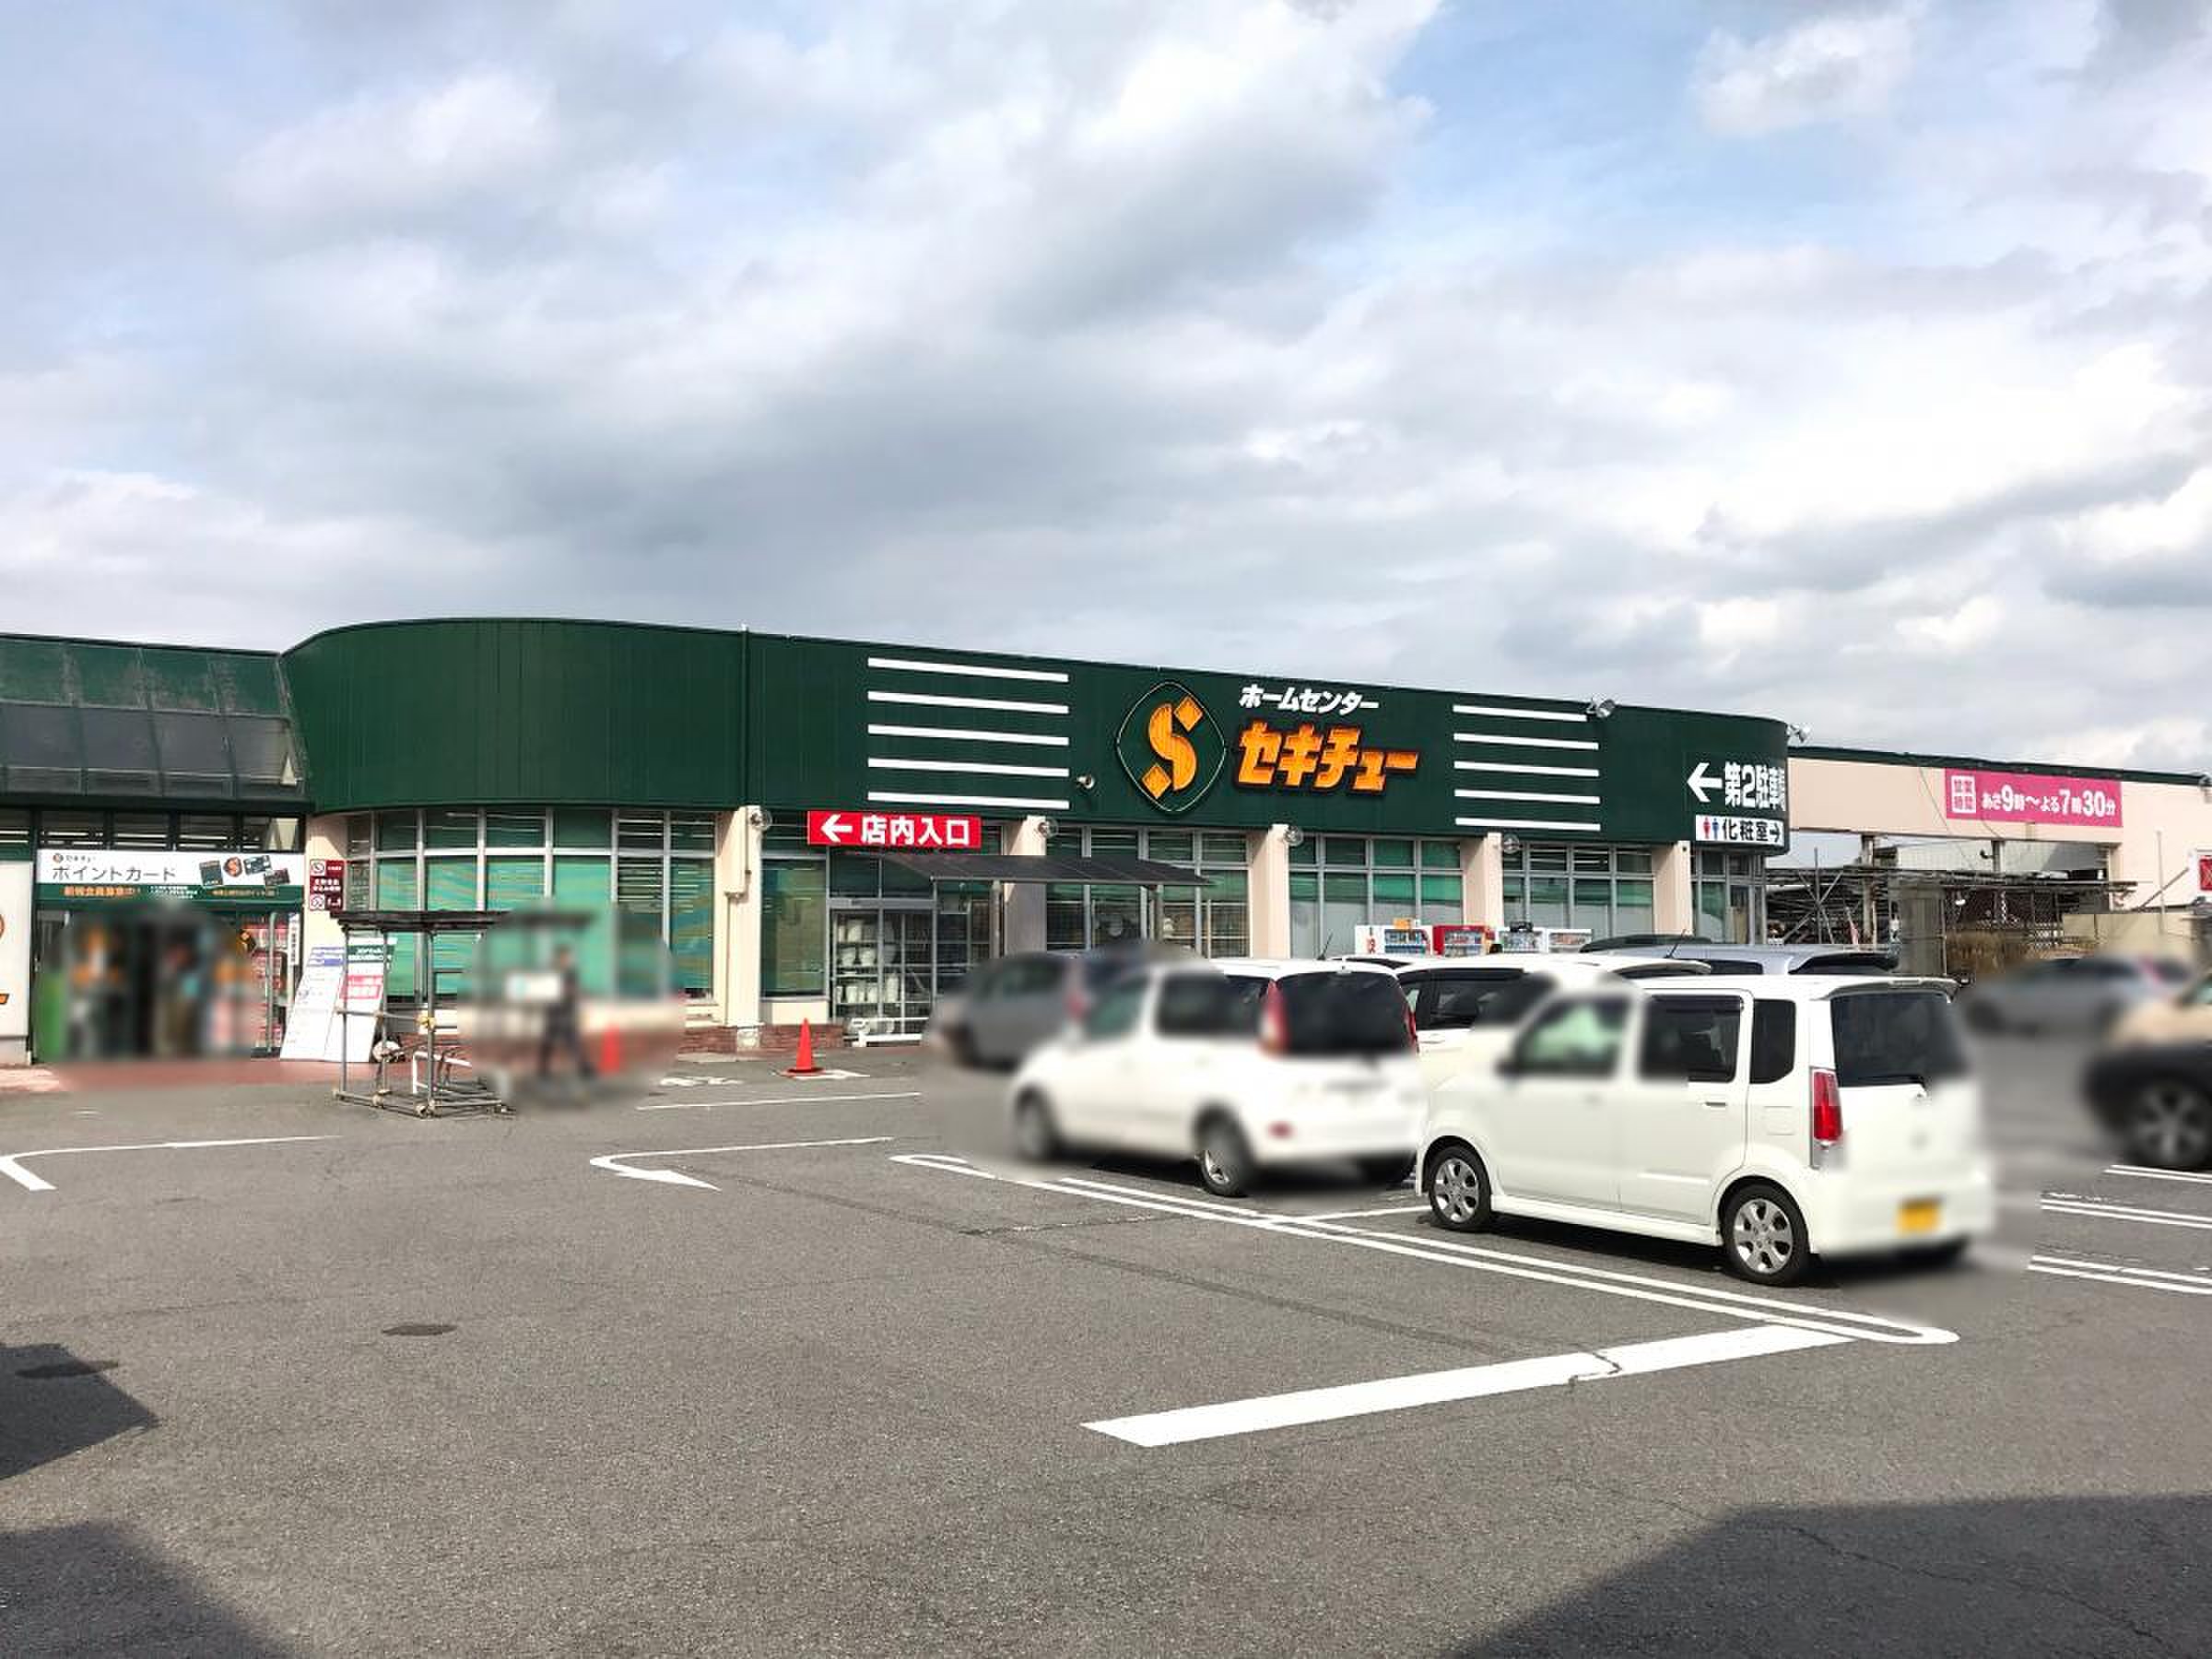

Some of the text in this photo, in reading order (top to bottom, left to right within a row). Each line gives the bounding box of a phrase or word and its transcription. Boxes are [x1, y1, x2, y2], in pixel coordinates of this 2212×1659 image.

[1239, 684, 1380, 715] ホームセンター
[1236, 719, 1418, 794] セキチュー
[861, 814, 970, 846] 店内入口
[1722, 818, 1769, 842] 化粧室
[53, 865, 176, 882] ポイントカード
